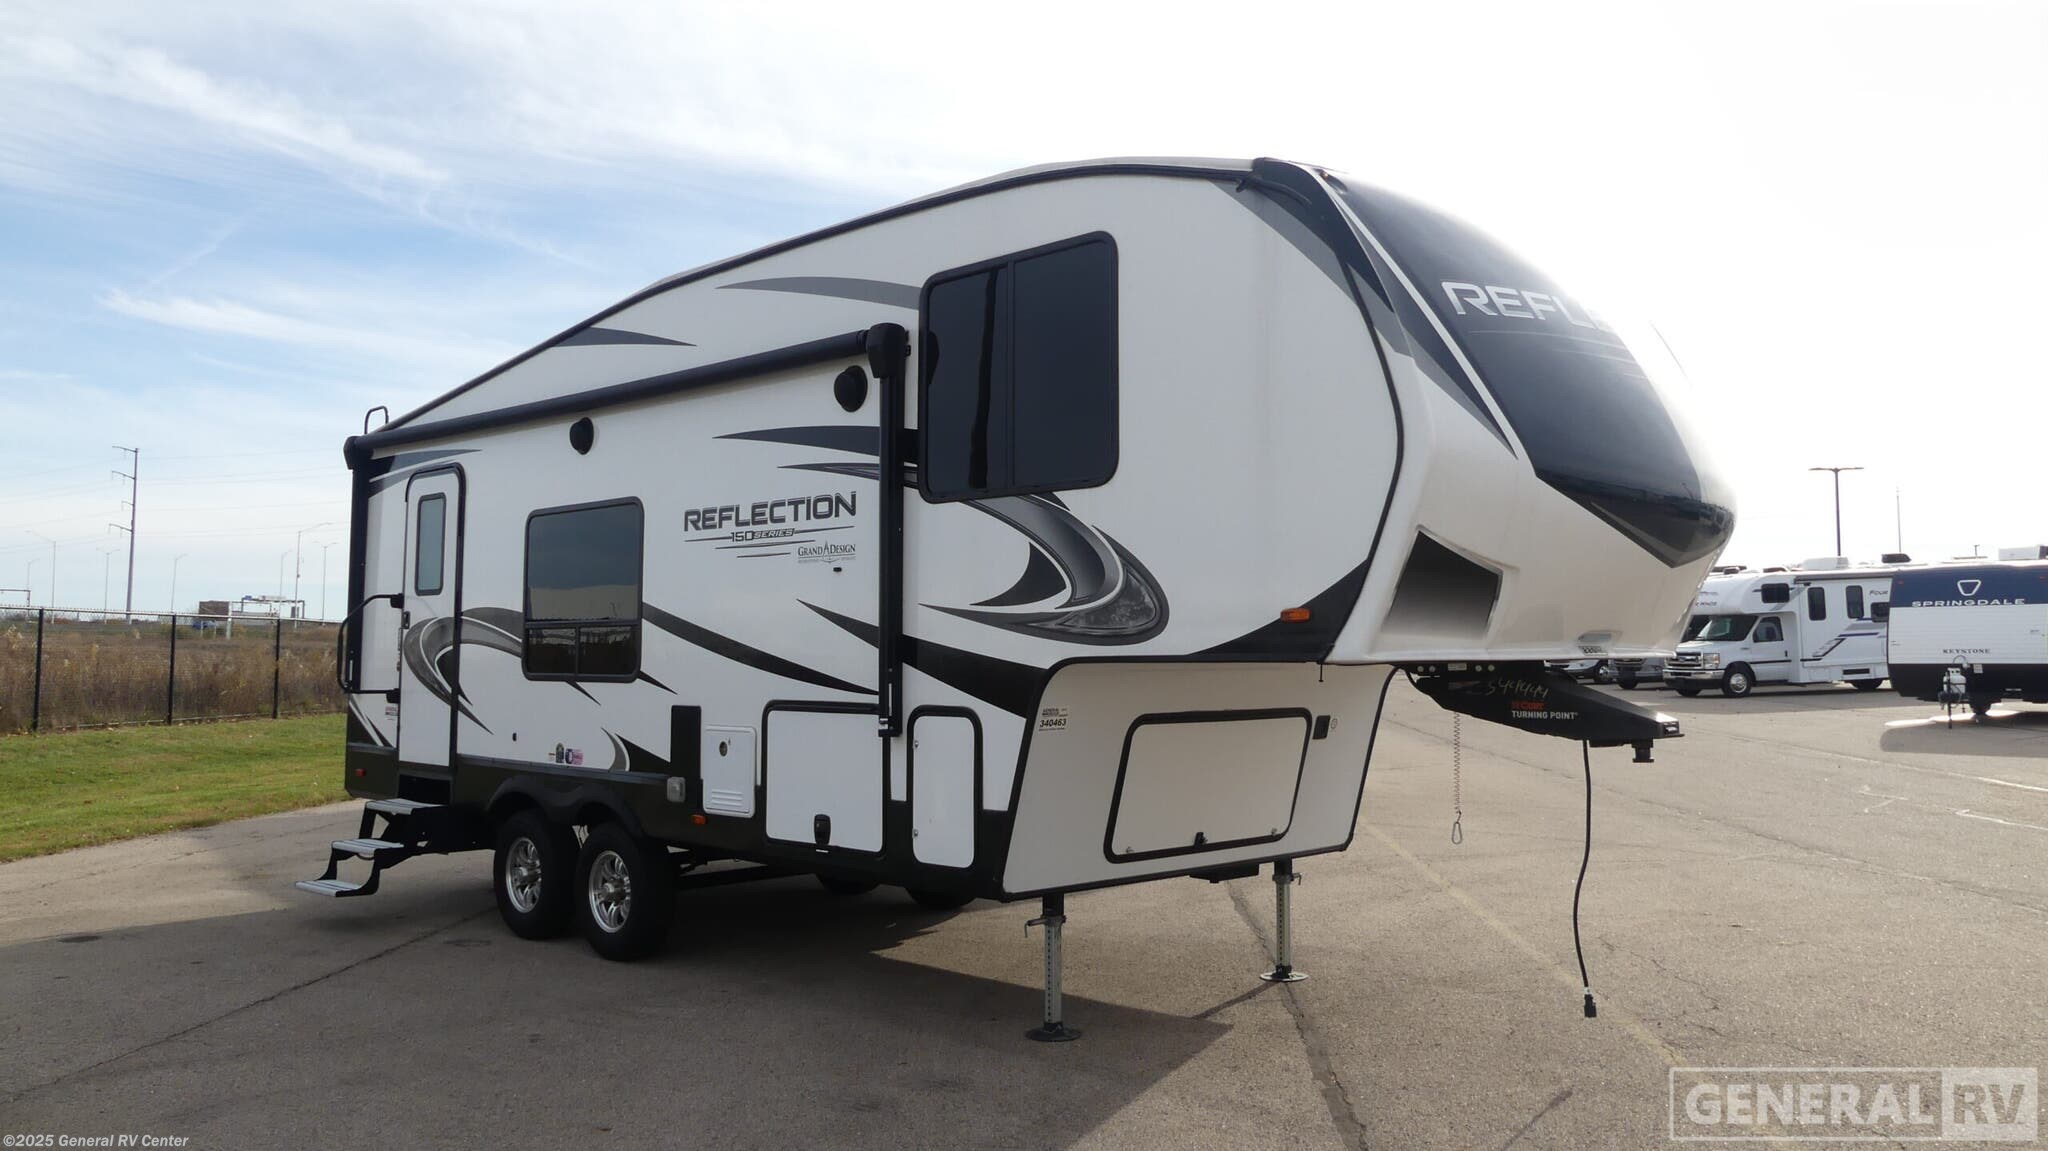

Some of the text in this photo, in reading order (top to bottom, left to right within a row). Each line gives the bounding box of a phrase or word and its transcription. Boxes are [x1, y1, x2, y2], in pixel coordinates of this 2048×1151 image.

[684, 491, 857, 532] REFLECTION
[731, 527, 795, 542] 150 SERIES
[1912, 598, 2025, 607] SPRINGDALE
[1512, 710, 1548, 719] TURNING
